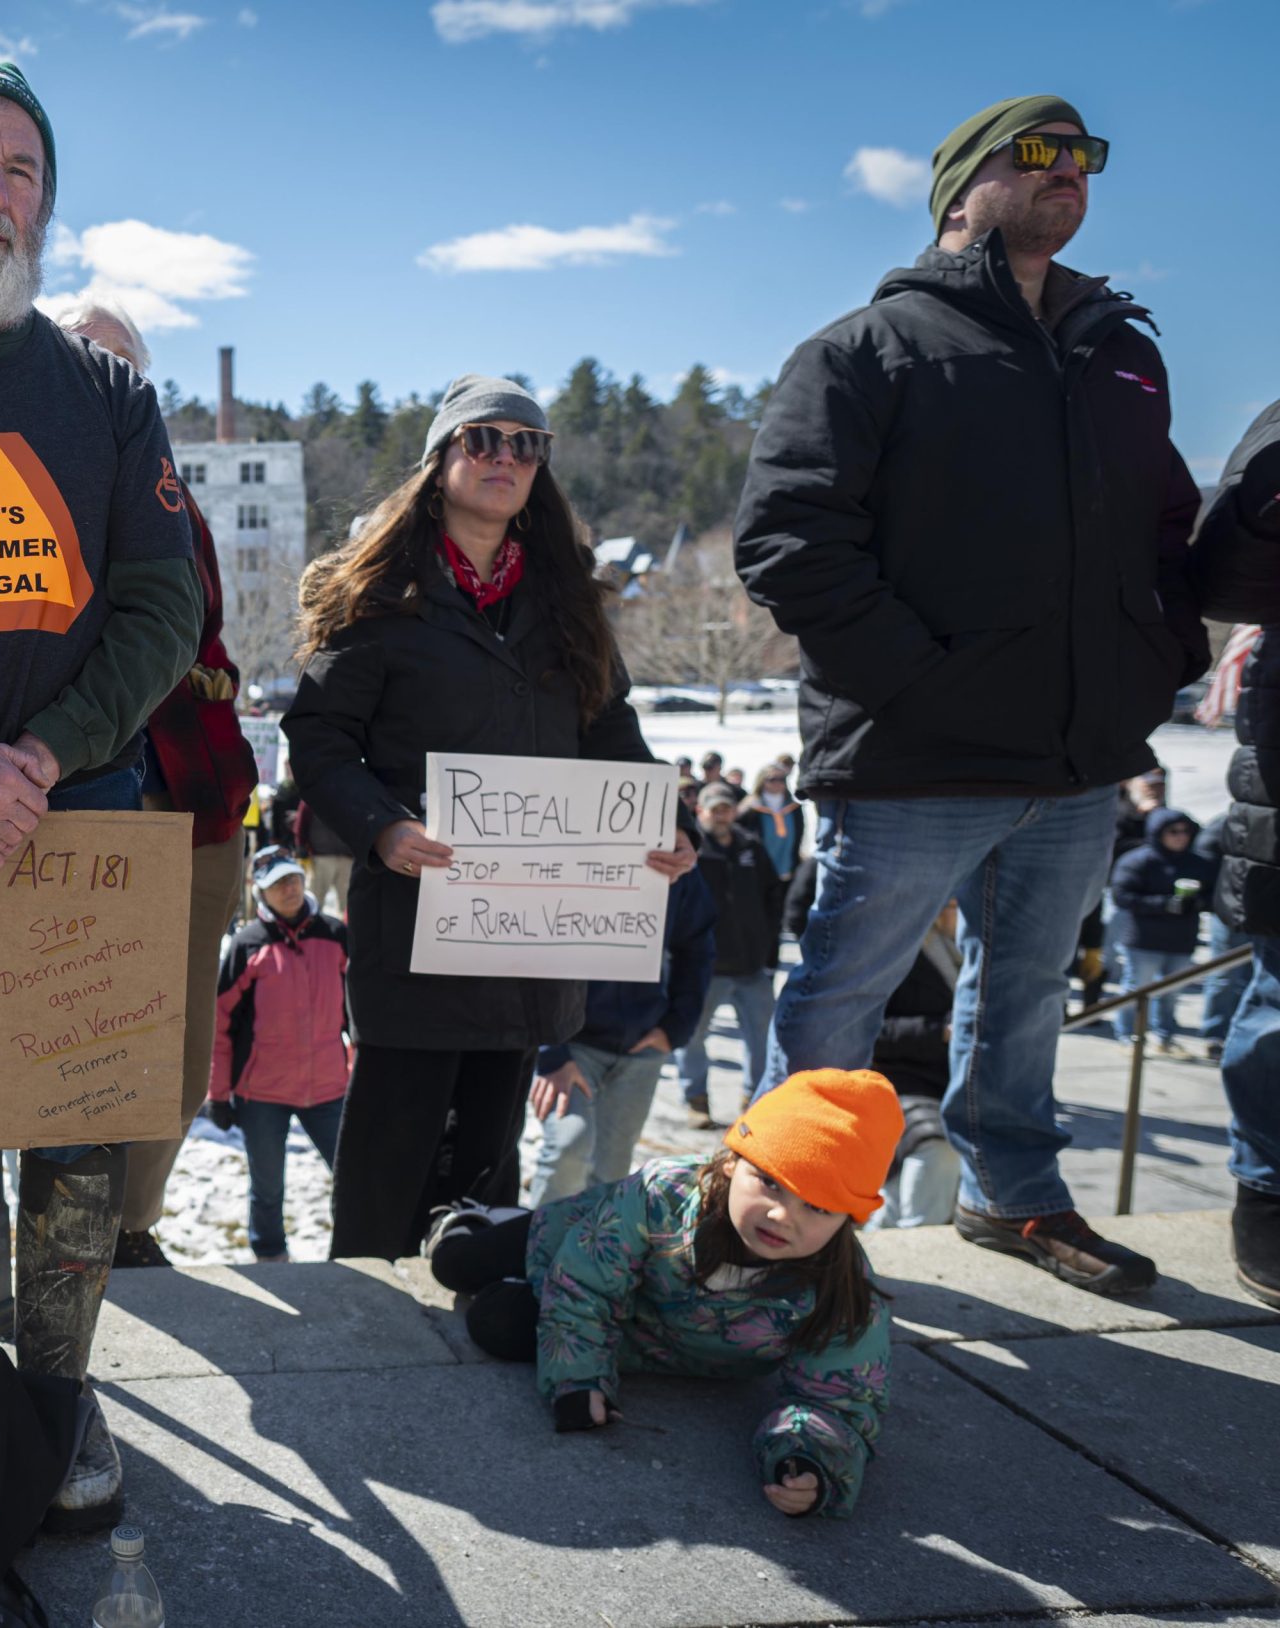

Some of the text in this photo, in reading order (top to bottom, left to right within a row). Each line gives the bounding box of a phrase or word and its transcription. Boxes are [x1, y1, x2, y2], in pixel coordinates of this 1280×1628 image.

[445, 768, 669, 849] REPEAL 181!
[8, 840, 76, 889] ACT
[91, 855, 130, 890] 181
[445, 861, 643, 886] STOP THE THEFT
[29, 915, 97, 950] Stop
[436, 898, 658, 939] OF RURAL VERMONTERS
[48, 976, 113, 1011] against
[10, 990, 167, 1057] Rural Vermont
[57, 1049, 128, 1081] Farmers
[38, 1080, 122, 1118] Generational
[80, 1089, 138, 1120] Families
